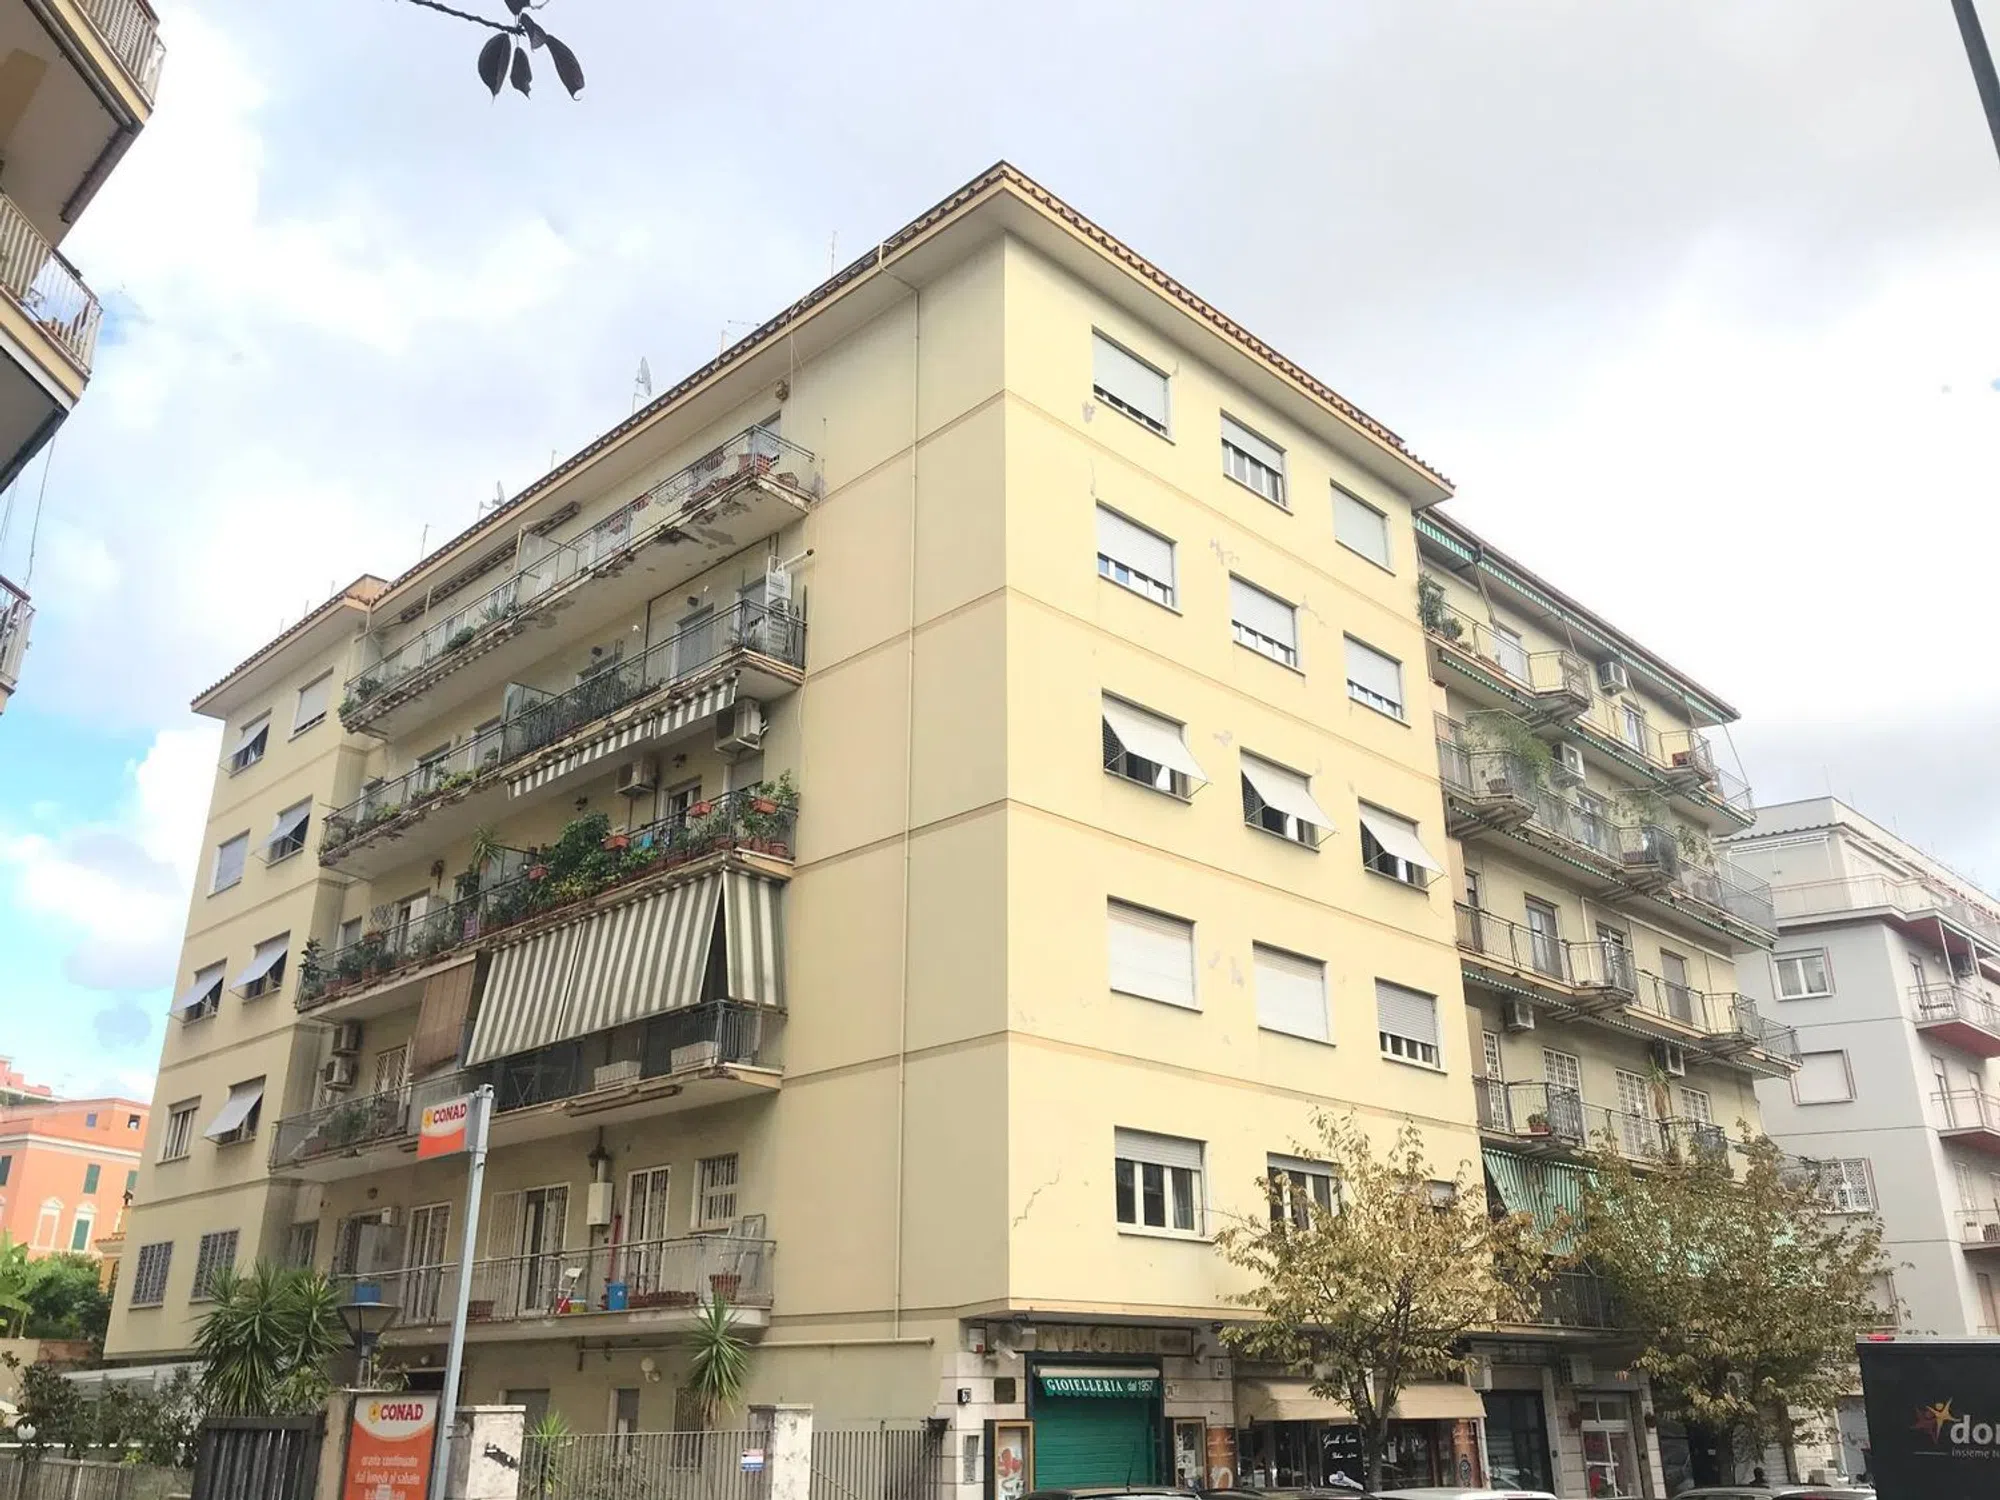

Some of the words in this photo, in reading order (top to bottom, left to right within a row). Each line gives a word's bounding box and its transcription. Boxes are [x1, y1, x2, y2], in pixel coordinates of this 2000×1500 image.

[433, 1103, 467, 1124] CONAD
[1046, 1379, 1123, 1392] GIOIELLERIA
[381, 1403, 424, 1421] CONAD
